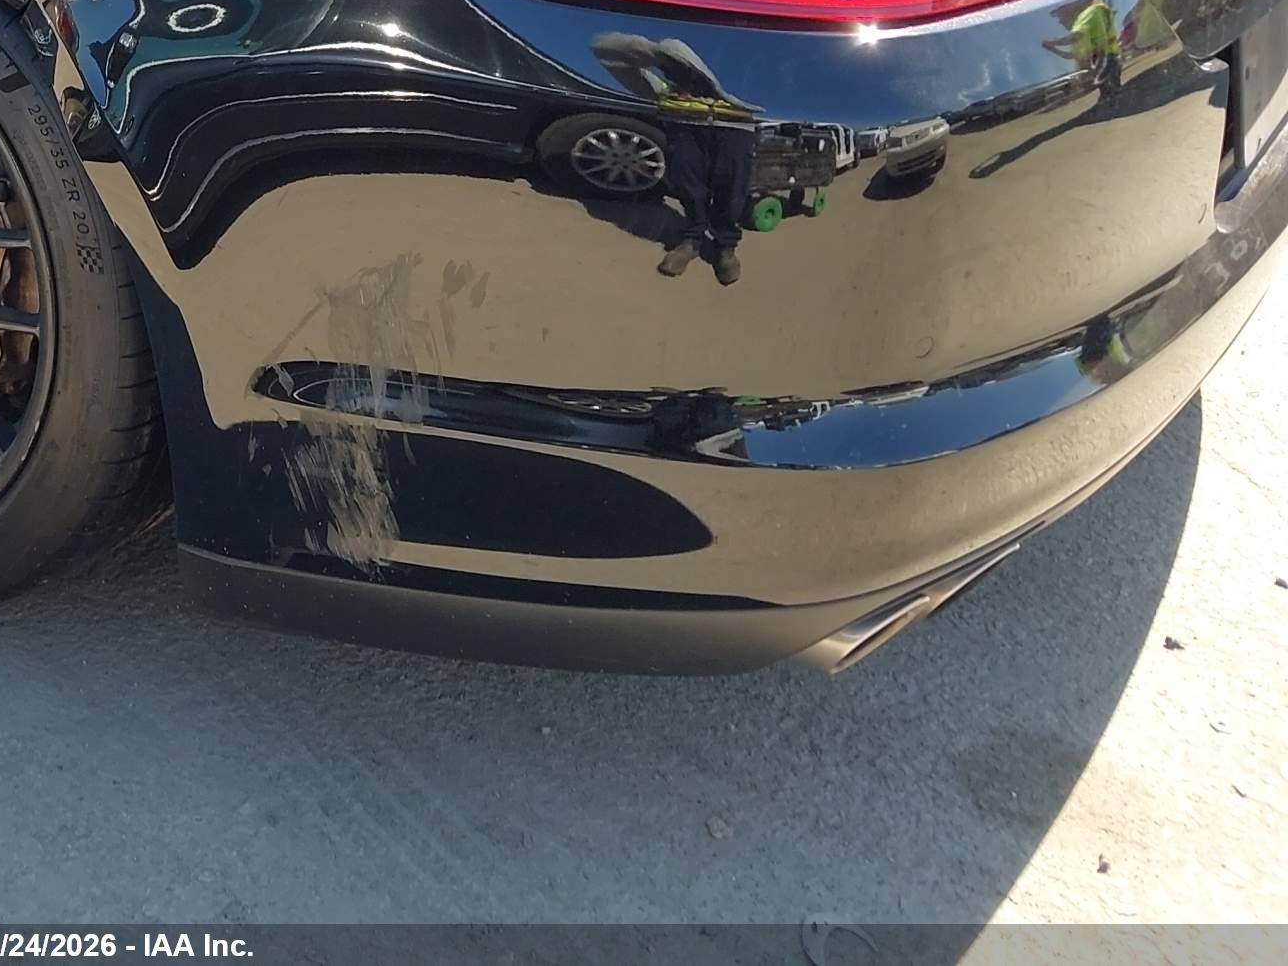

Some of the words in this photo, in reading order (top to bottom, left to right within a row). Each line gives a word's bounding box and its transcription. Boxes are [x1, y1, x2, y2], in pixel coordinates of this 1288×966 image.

[27, 104, 70, 170] 295/35
[61, 177, 81, 202] ZR
[72, 211, 90, 235] 20
